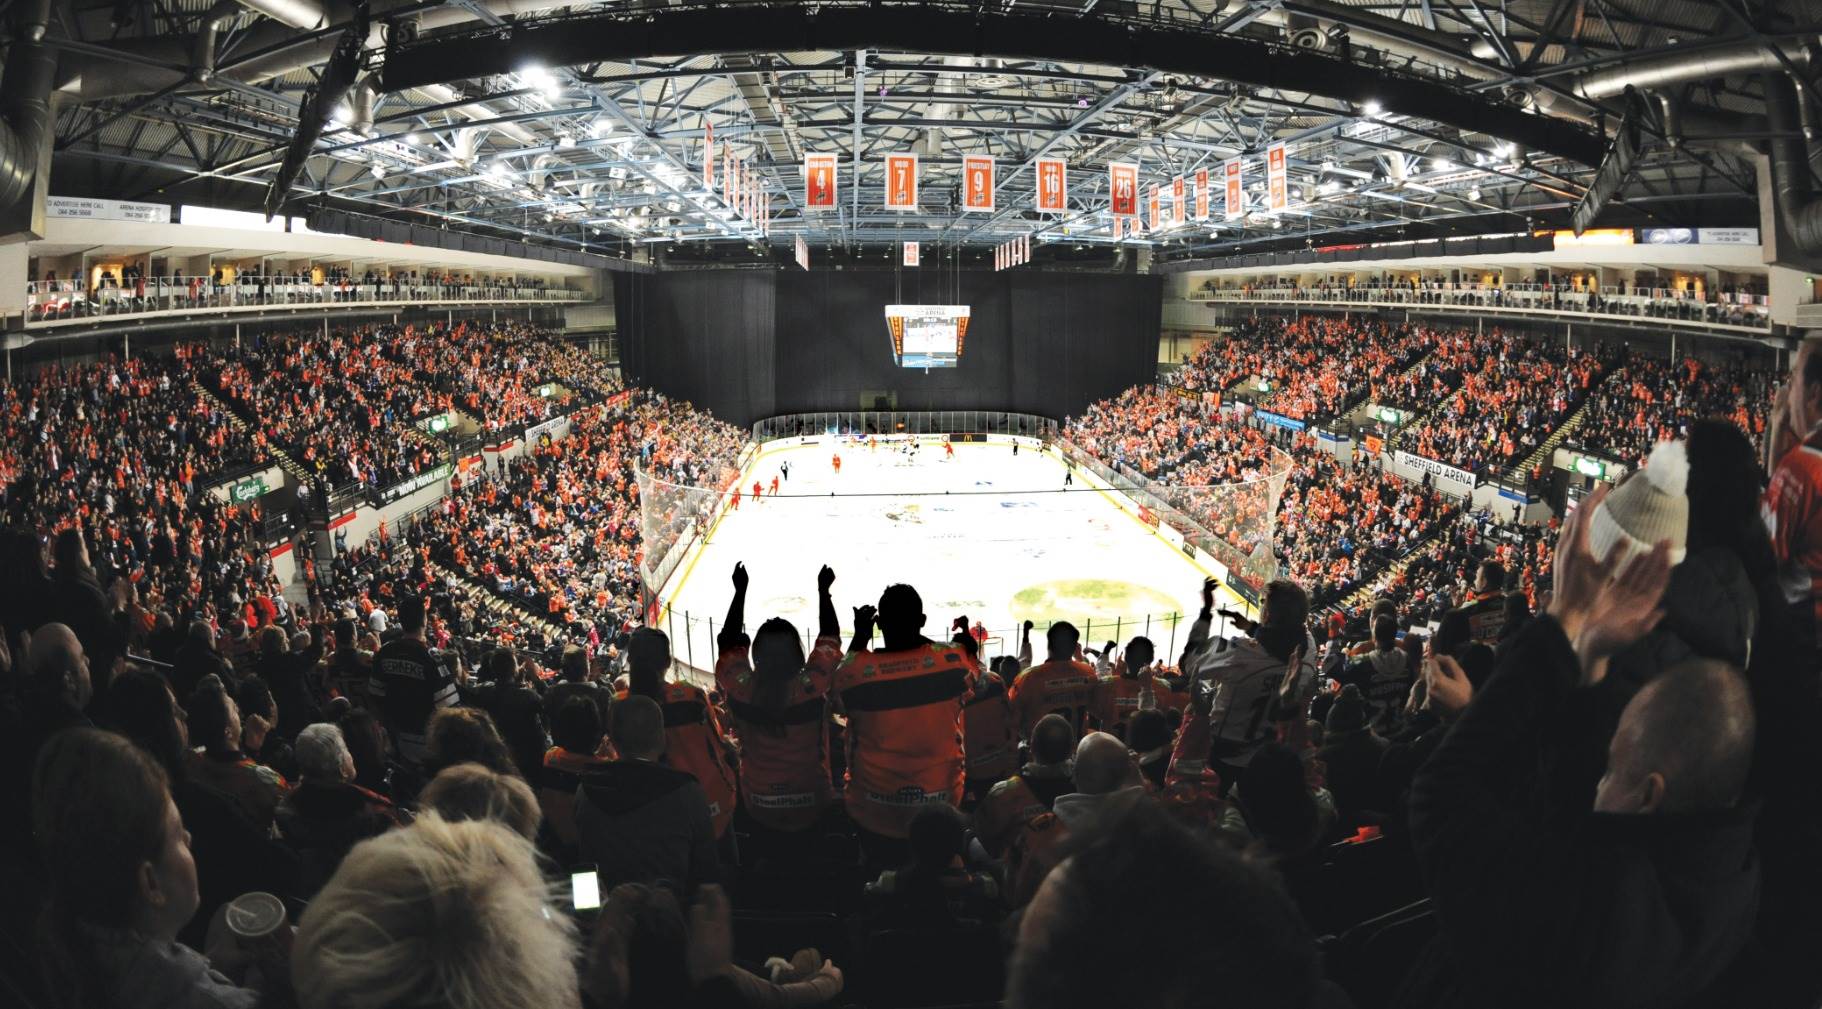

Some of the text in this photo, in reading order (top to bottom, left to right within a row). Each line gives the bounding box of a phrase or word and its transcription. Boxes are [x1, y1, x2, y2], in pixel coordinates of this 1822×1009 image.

[816, 169, 826, 190] 4
[897, 169, 906, 190] 7
[973, 171, 984, 192] 9
[1043, 173, 1060, 193] 16
[1115, 178, 1132, 199] 26
[416, 466, 449, 488] AVAILABLE
[1404, 455, 1442, 476] SHEFFIELD
[1443, 467, 1472, 486] ARENA
[236, 483, 260, 501] Carlsberg
